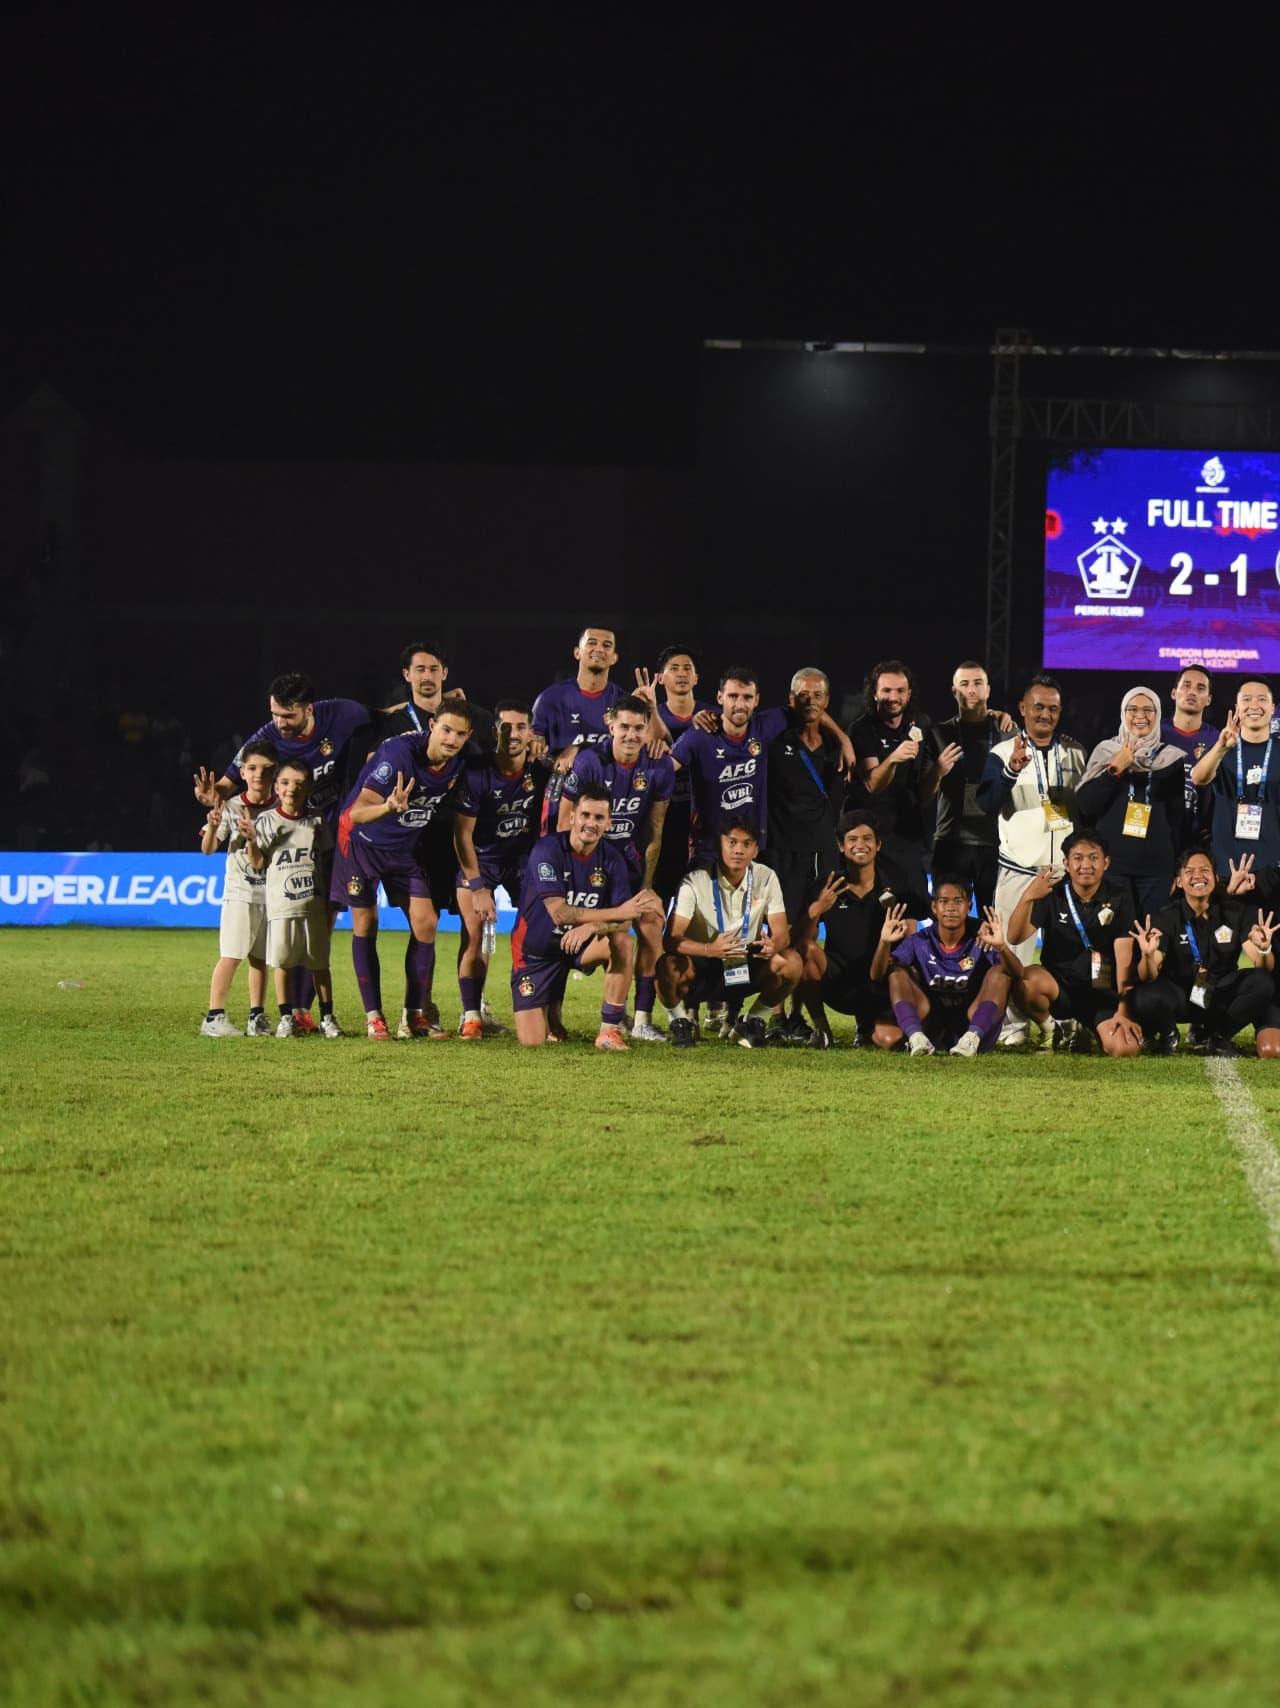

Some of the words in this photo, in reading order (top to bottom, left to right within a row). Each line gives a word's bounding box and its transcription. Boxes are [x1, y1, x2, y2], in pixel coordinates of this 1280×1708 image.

[1147, 499, 1212, 528] FULL
[1217, 501, 1279, 529] TIME
[1169, 552, 1193, 595] 2
[1230, 553, 1247, 596] 1
[718, 759, 757, 779] AFG
[728, 786, 750, 800] WBI
[290, 876, 314, 889] WB
[567, 890, 599, 908] AFG
